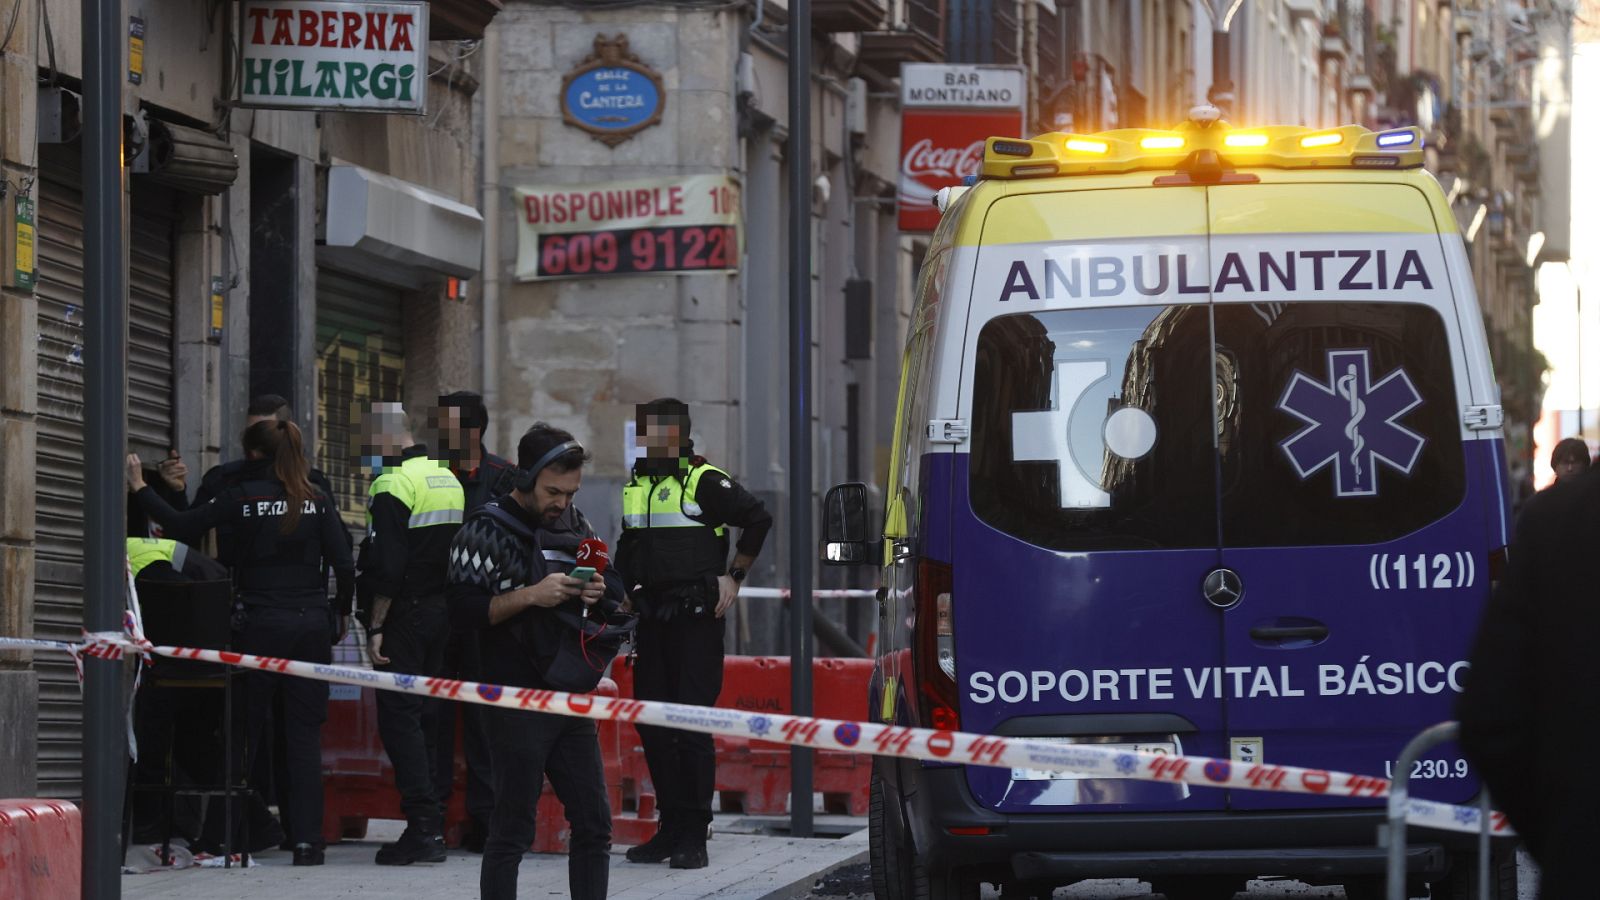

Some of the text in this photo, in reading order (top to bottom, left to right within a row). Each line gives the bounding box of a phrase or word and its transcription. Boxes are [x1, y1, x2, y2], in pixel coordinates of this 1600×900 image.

[248, 8, 414, 51] TABERNA
[595, 71, 631, 81] CALLE
[598, 83, 628, 91] DE LA
[910, 87, 1012, 101] MONTIJANO
[944, 73, 980, 86] BAR
[524, 187, 683, 224] DISPONIBLE
[542, 232, 619, 274] 609
[998, 249, 1434, 302] ANBULANTZIA
[969, 668, 1174, 704] SOPORTE
[1183, 665, 1305, 699] VITAL
